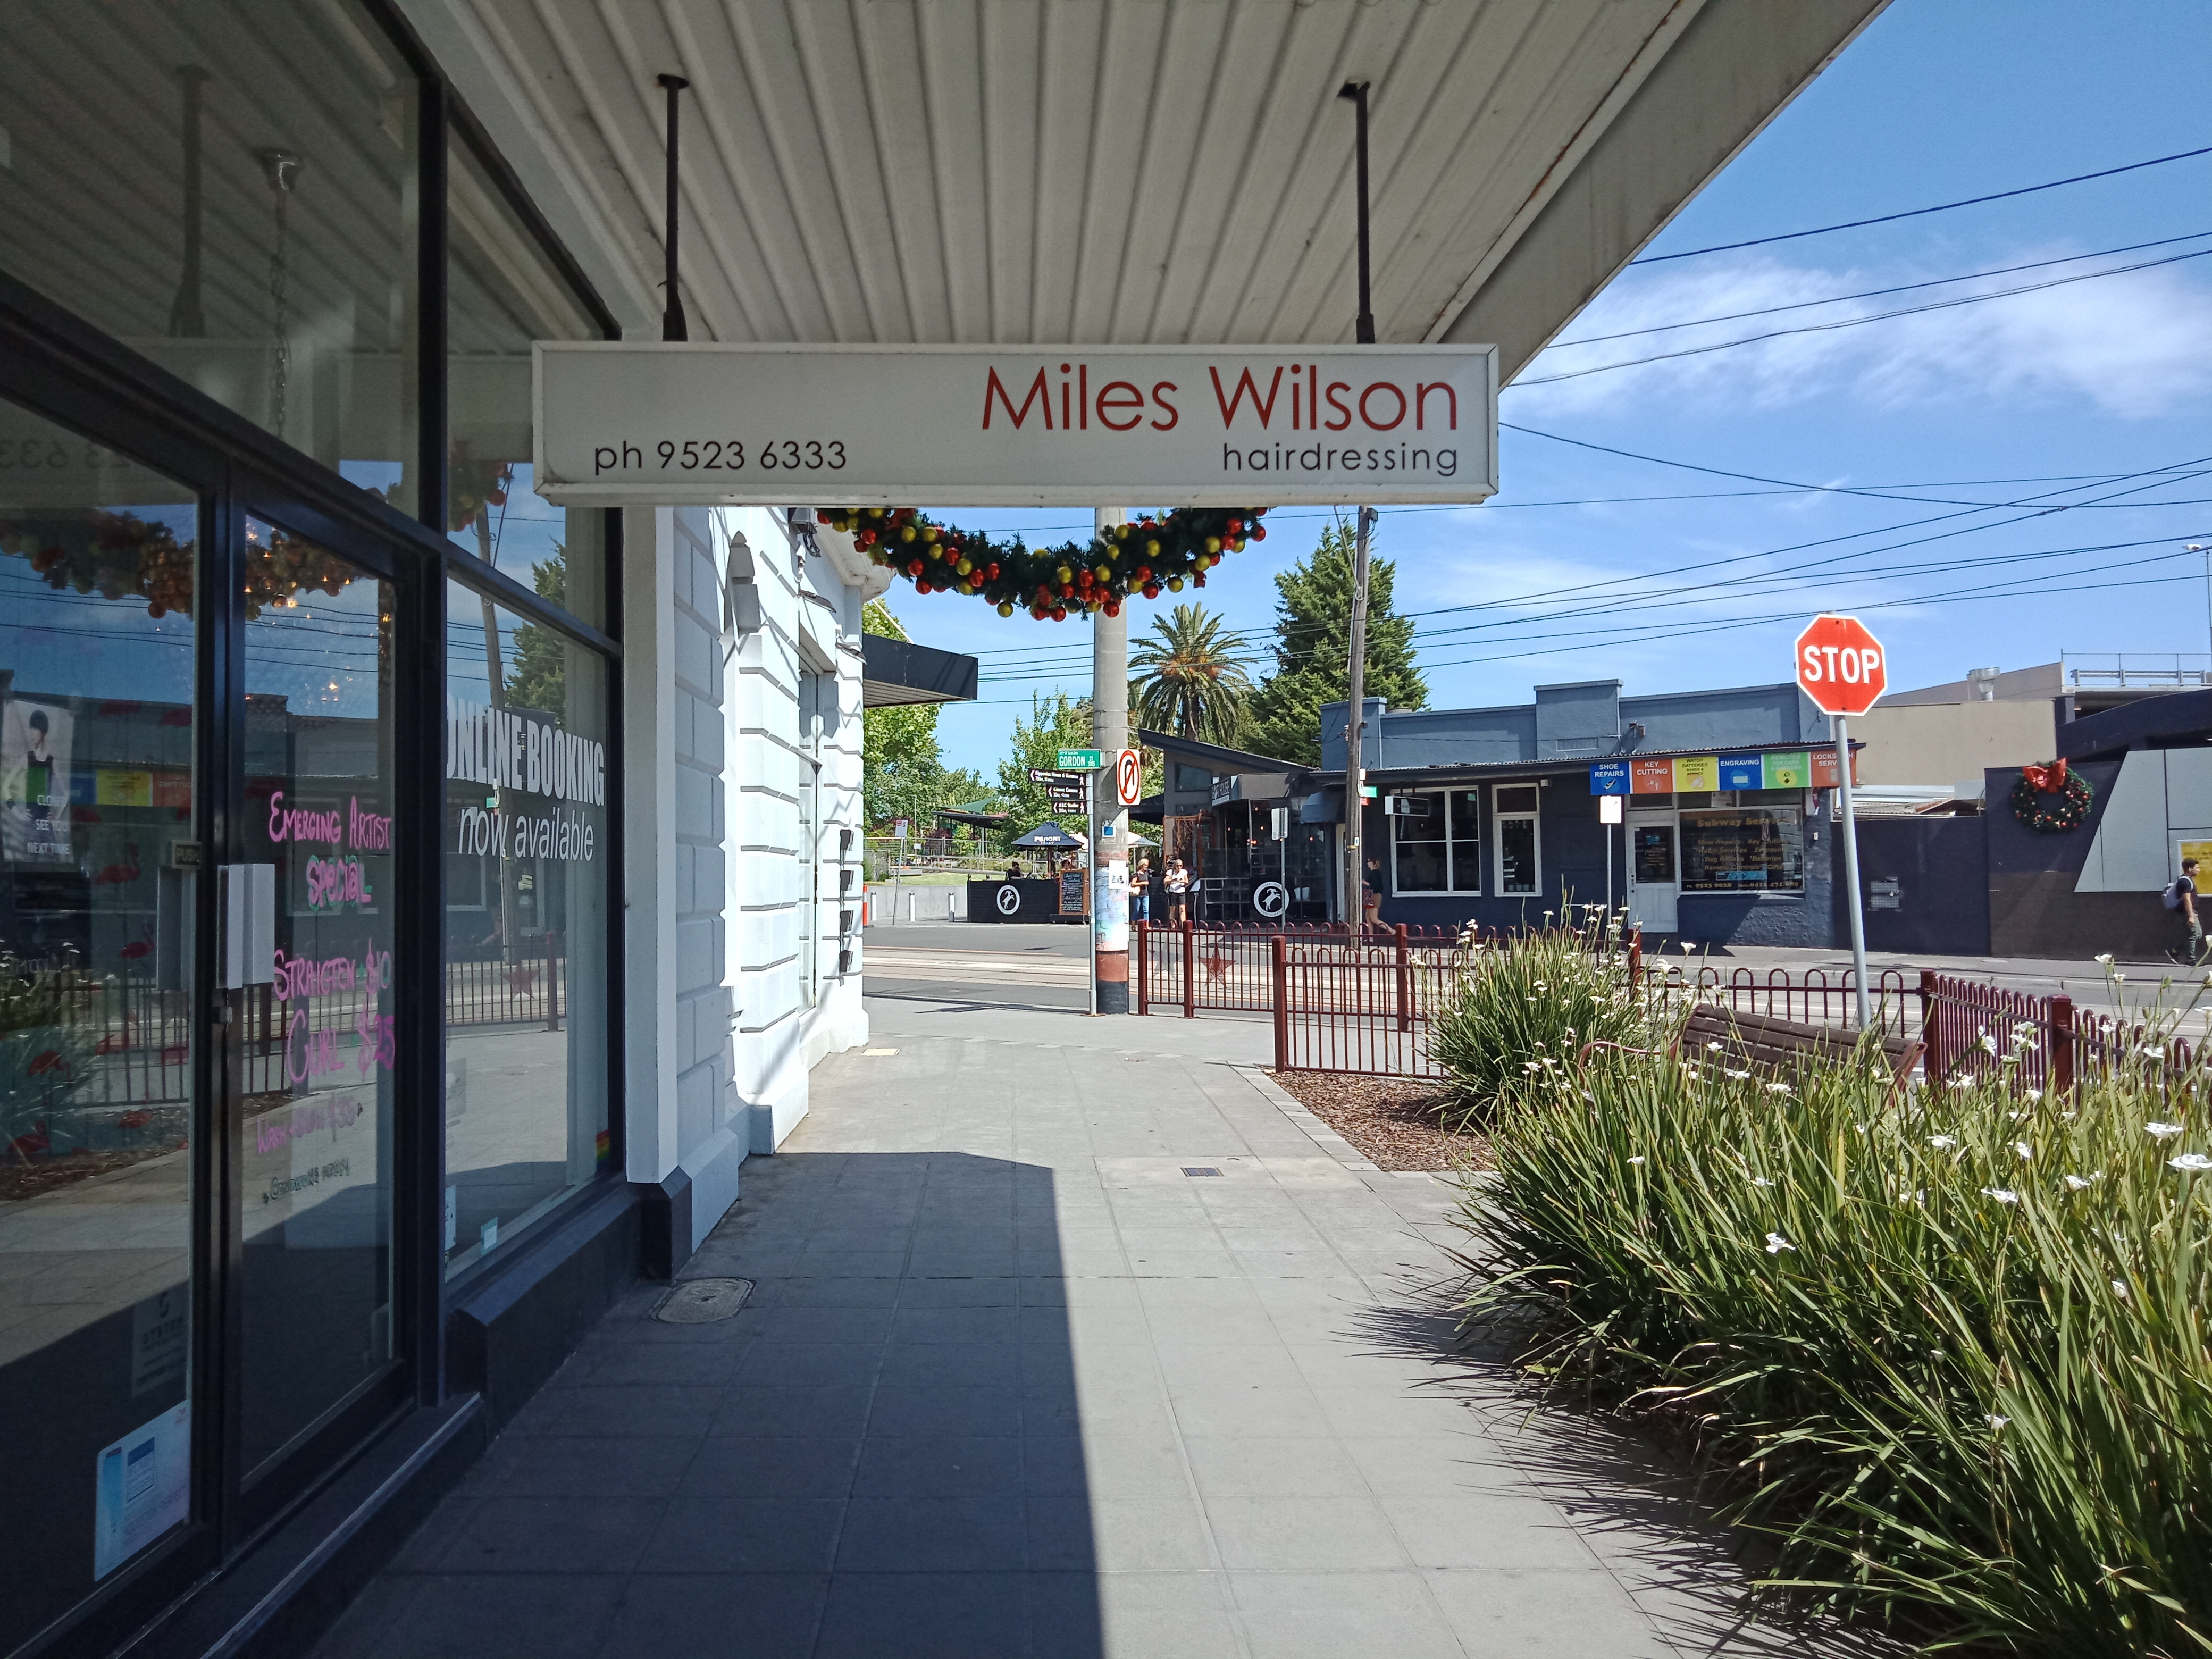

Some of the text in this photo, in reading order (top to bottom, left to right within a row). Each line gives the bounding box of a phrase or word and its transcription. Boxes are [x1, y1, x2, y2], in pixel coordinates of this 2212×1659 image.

[982, 364, 1457, 432] Miles Wilson
[594, 440, 847, 476] ph 9523 6333
[1224, 442, 1457, 476] hairdressing
[1804, 645, 1880, 684] STOP
[527, 719, 605, 806] BOOKING
[1059, 756, 1085, 767] GORDON
[1636, 767, 1668, 776] CUTTING
[1720, 758, 1759, 767] ENGRAVING
[269, 791, 392, 850] EMERGING ARTIST
[458, 806, 594, 862] now available
[1697, 818, 1742, 827] Subway
